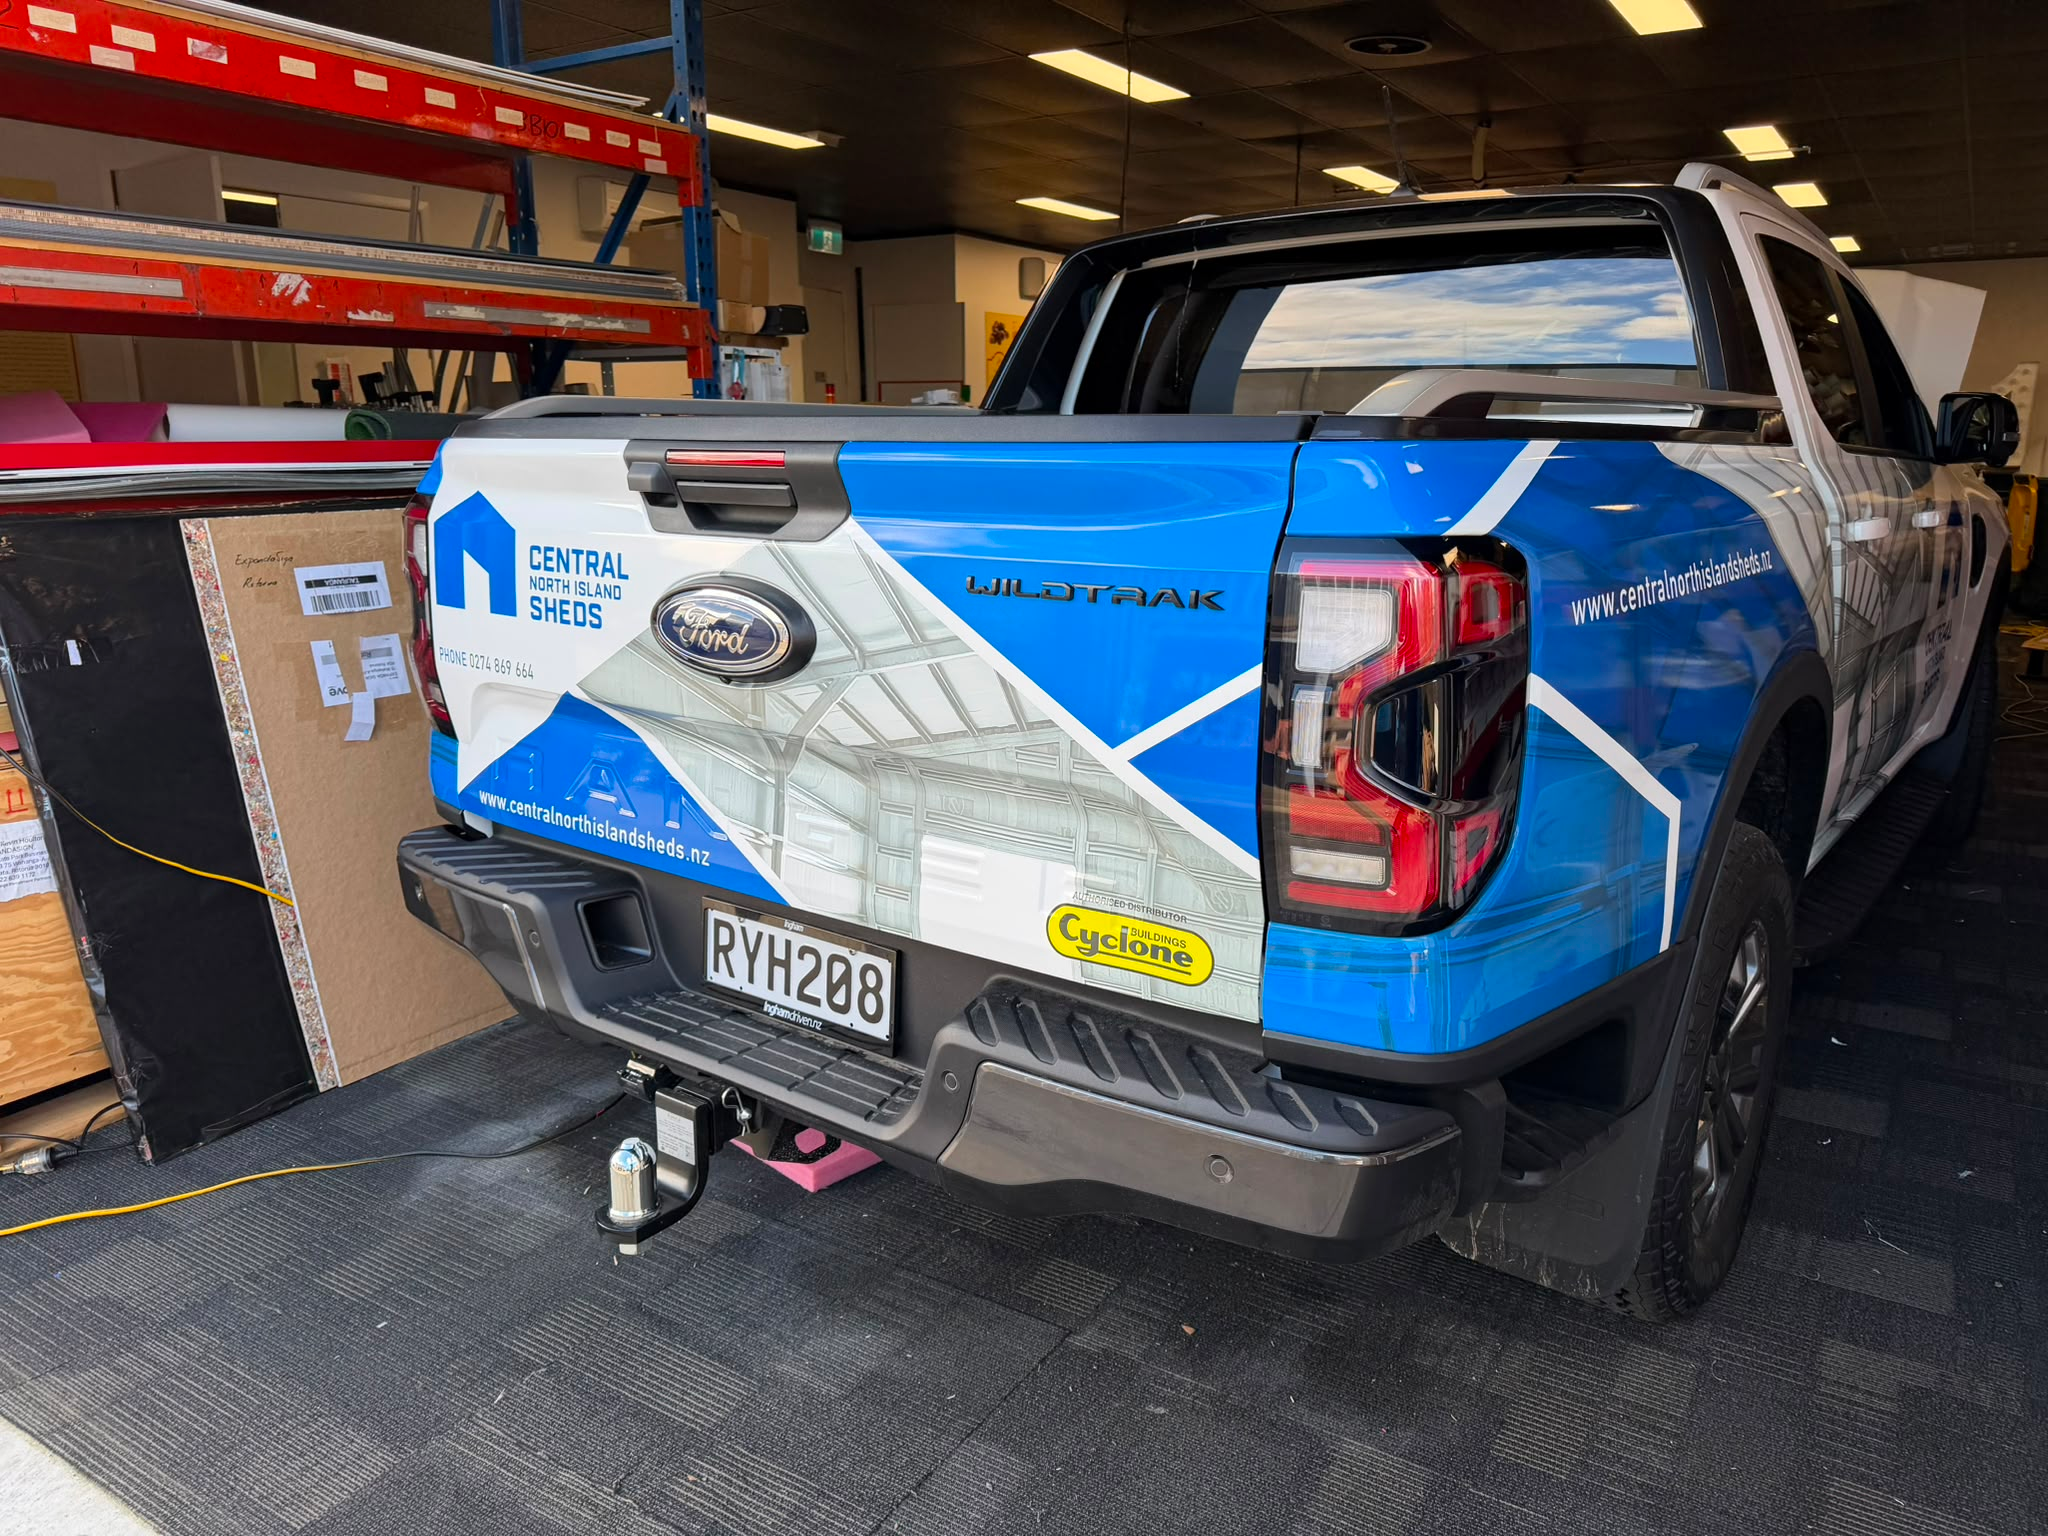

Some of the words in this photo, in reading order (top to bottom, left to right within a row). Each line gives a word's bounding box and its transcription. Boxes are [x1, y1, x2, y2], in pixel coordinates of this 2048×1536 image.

[529, 544, 630, 580] CENTRAL
[529, 575, 571, 595] NORTH
[574, 580, 622, 600] ISLAND
[965, 575, 1225, 611] WILDTRAK
[1571, 548, 1773, 625] www.centralnorthislandsheds.nz
[529, 595, 603, 630] SHEDS
[672, 601, 752, 655] Ford
[439, 646, 467, 667] PHONE
[469, 653, 492, 672] 0274
[494, 657, 512, 675] 869
[516, 661, 534, 680] 664
[479, 789, 711, 867] www.centralnorthislandsheds.nz
[1072, 891, 1126, 909] AUTHORISED
[1127, 903, 1188, 924] DISTRIBUTOR
[783, 919, 804, 932] Ingham
[1059, 913, 1194, 968] Cyclone
[1130, 927, 1187, 949] BUILDINGS
[713, 917, 884, 1024] RYH208
[763, 1001, 823, 1031] Inghamdriven.nz
